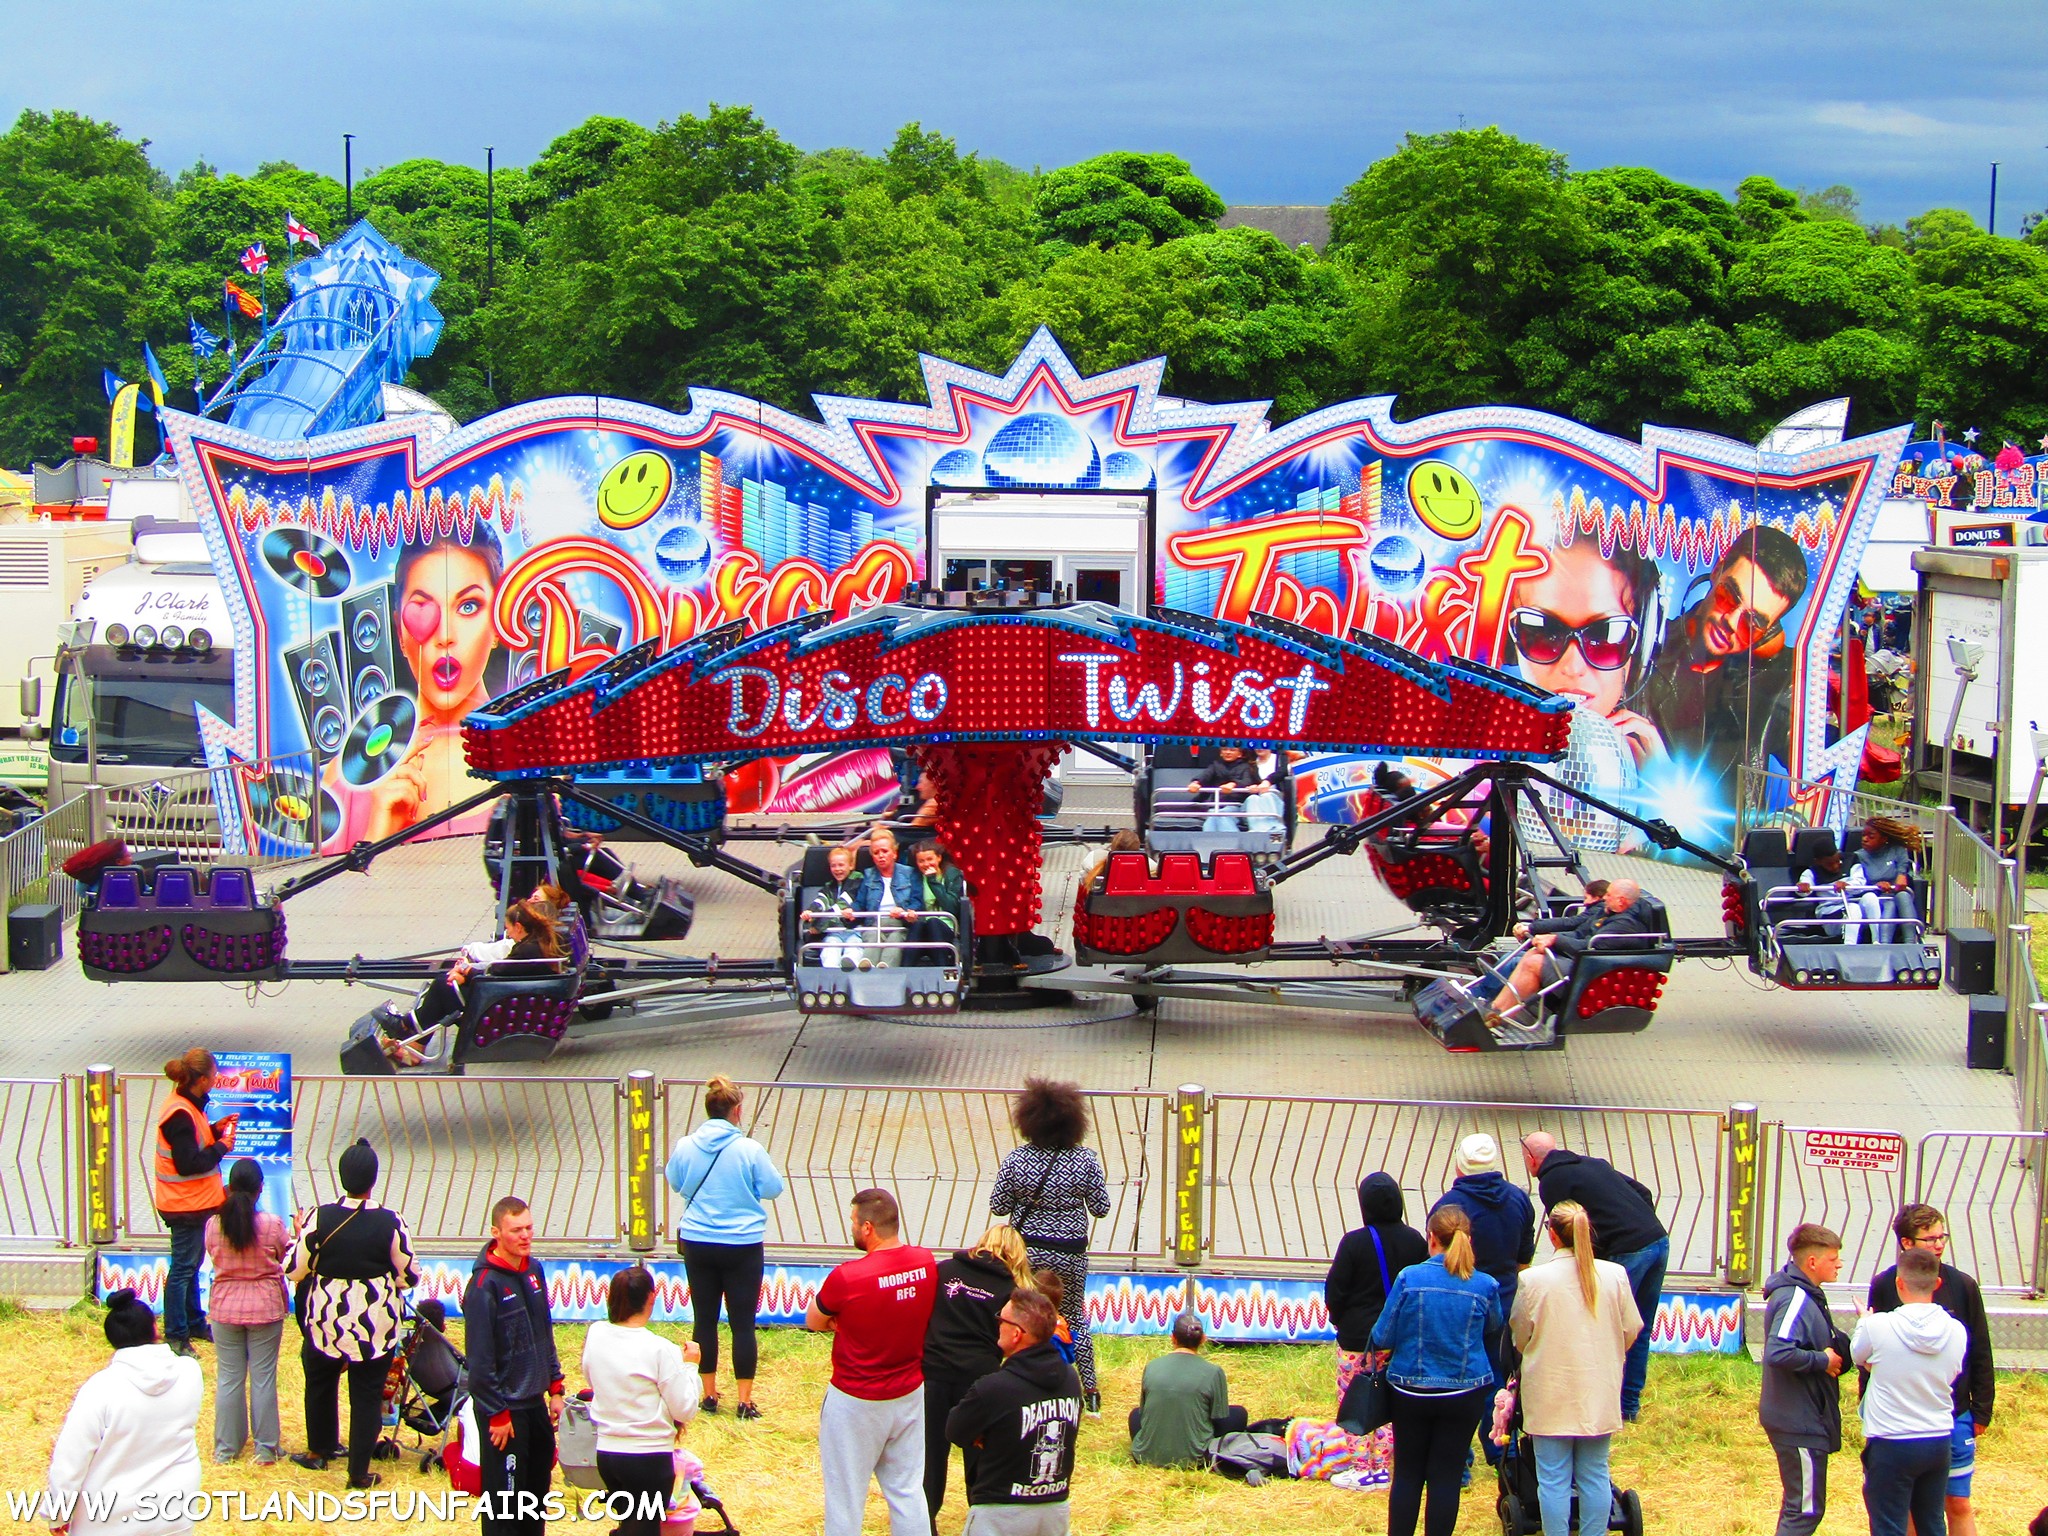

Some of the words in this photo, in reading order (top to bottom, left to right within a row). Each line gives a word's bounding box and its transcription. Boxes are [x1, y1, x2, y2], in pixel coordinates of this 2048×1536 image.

[1894, 473, 1957, 507] CKY
[1955, 529, 2001, 542] DONUTS
[134, 591, 210, 615] J.Clark
[710, 665, 950, 740] Disco
[1057, 651, 1331, 736] Twist
[30, 755, 42, 763] SEE
[1317, 771, 1329, 781] 20
[1335, 767, 1346, 777] 40
[239, 1068, 284, 1093] Twist
[1807, 1132, 1900, 1151] CAUTION!
[90, 1084, 109, 1230] TWISTER
[630, 1089, 650, 1236] TWISTER
[1810, 1148, 1826, 1156] DO
[1856, 1152, 1894, 1161] STAND
[1843, 1159, 1879, 1168] STEPS
[1178, 1103, 1200, 1251] TWISTER
[1730, 1122, 1754, 1270] TWISTER
[878, 1266, 927, 1289] MORPETH
[896, 1286, 916, 1301] RFC
[1021, 1398, 1057, 1440] DEATH
[1058, 1397, 1080, 1429] ROW
[1011, 1477, 1068, 1496] RECORDS
